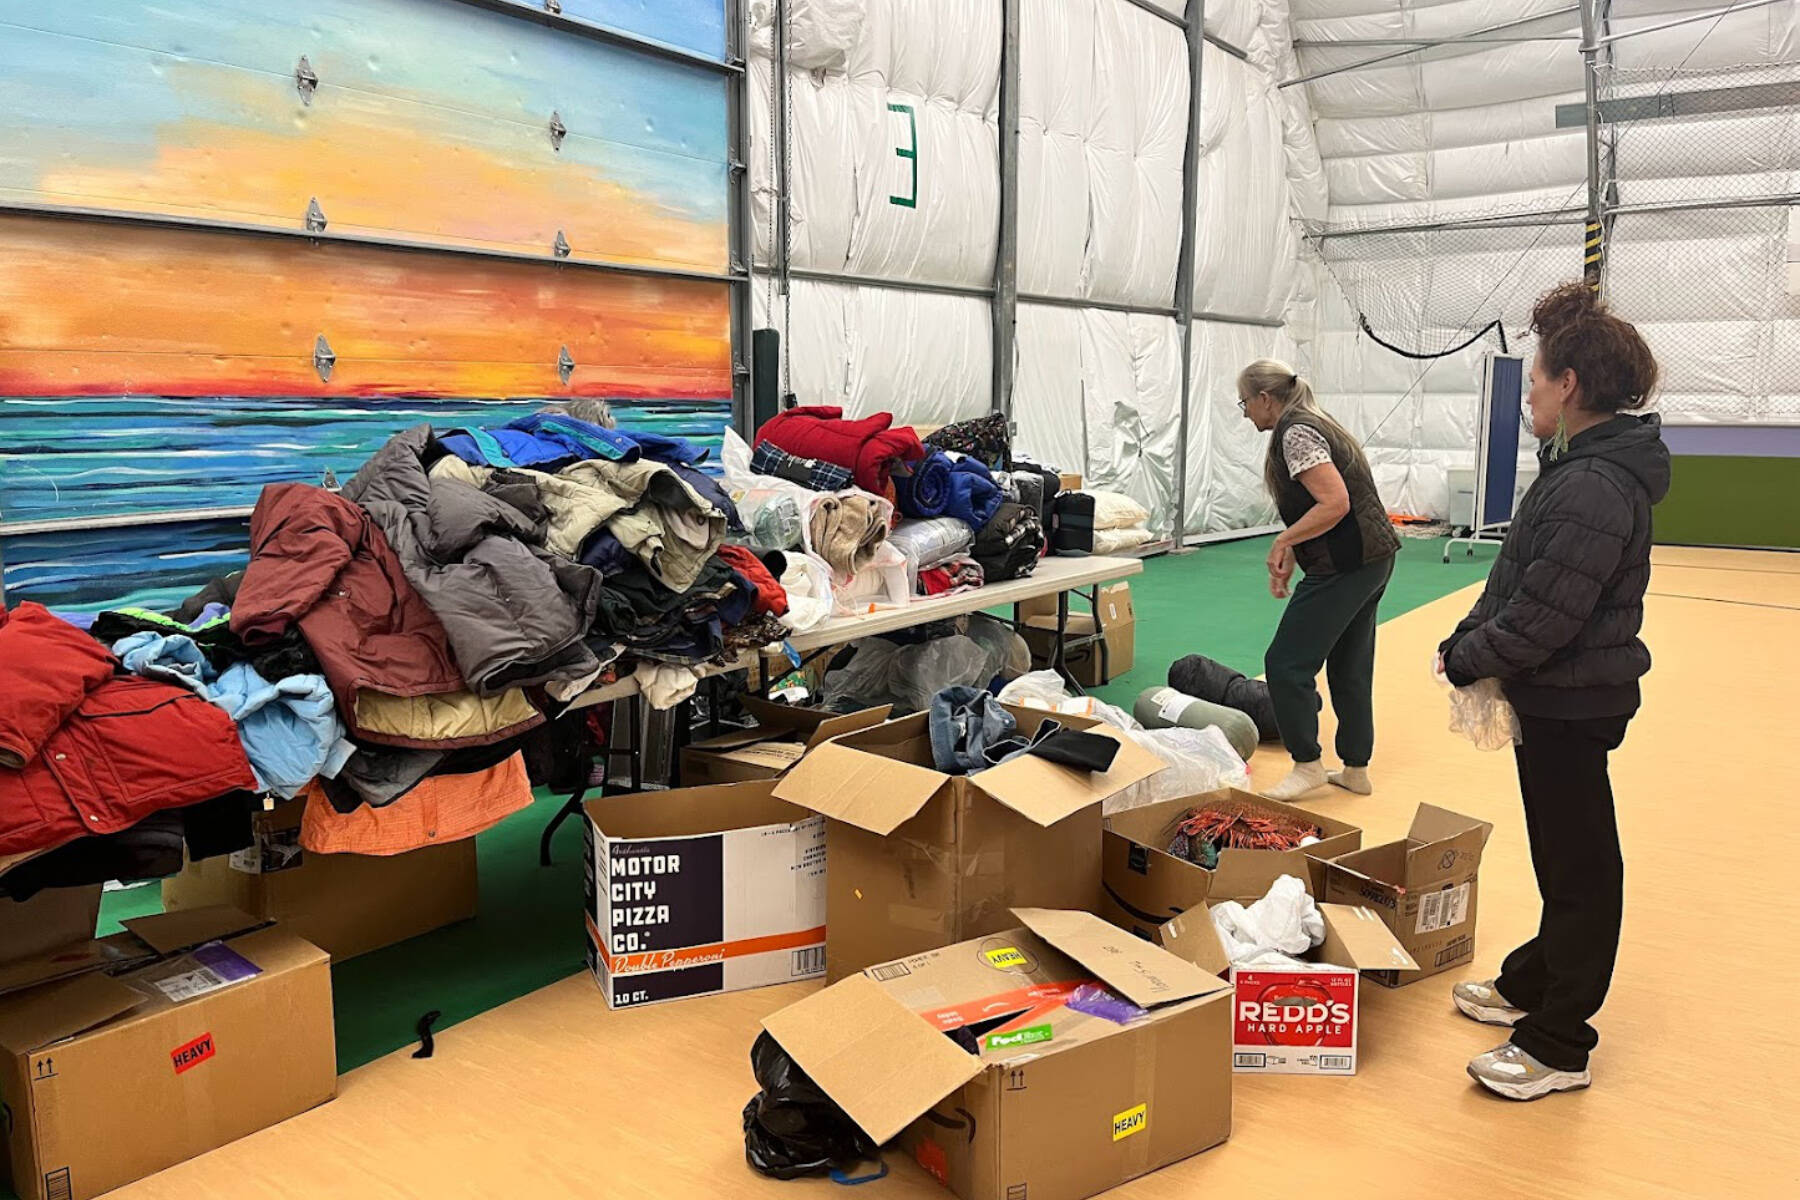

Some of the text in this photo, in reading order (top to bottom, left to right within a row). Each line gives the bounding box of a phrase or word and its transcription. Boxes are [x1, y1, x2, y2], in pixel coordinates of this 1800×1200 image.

[611, 854, 680, 877] MOTOR
[611, 881, 656, 902] CITY
[612, 904, 670, 927] PIZZA
[613, 932, 647, 952] CO.
[615, 948, 726, 974] Double Pepperoni
[614, 990, 649, 1005] 10 CT.
[1239, 999, 1351, 1025] REDD'S
[1247, 1022, 1342, 1035] HARD APPLE
[173, 1039, 211, 1068] HEAVY
[1114, 1110, 1145, 1136] HEAVY
